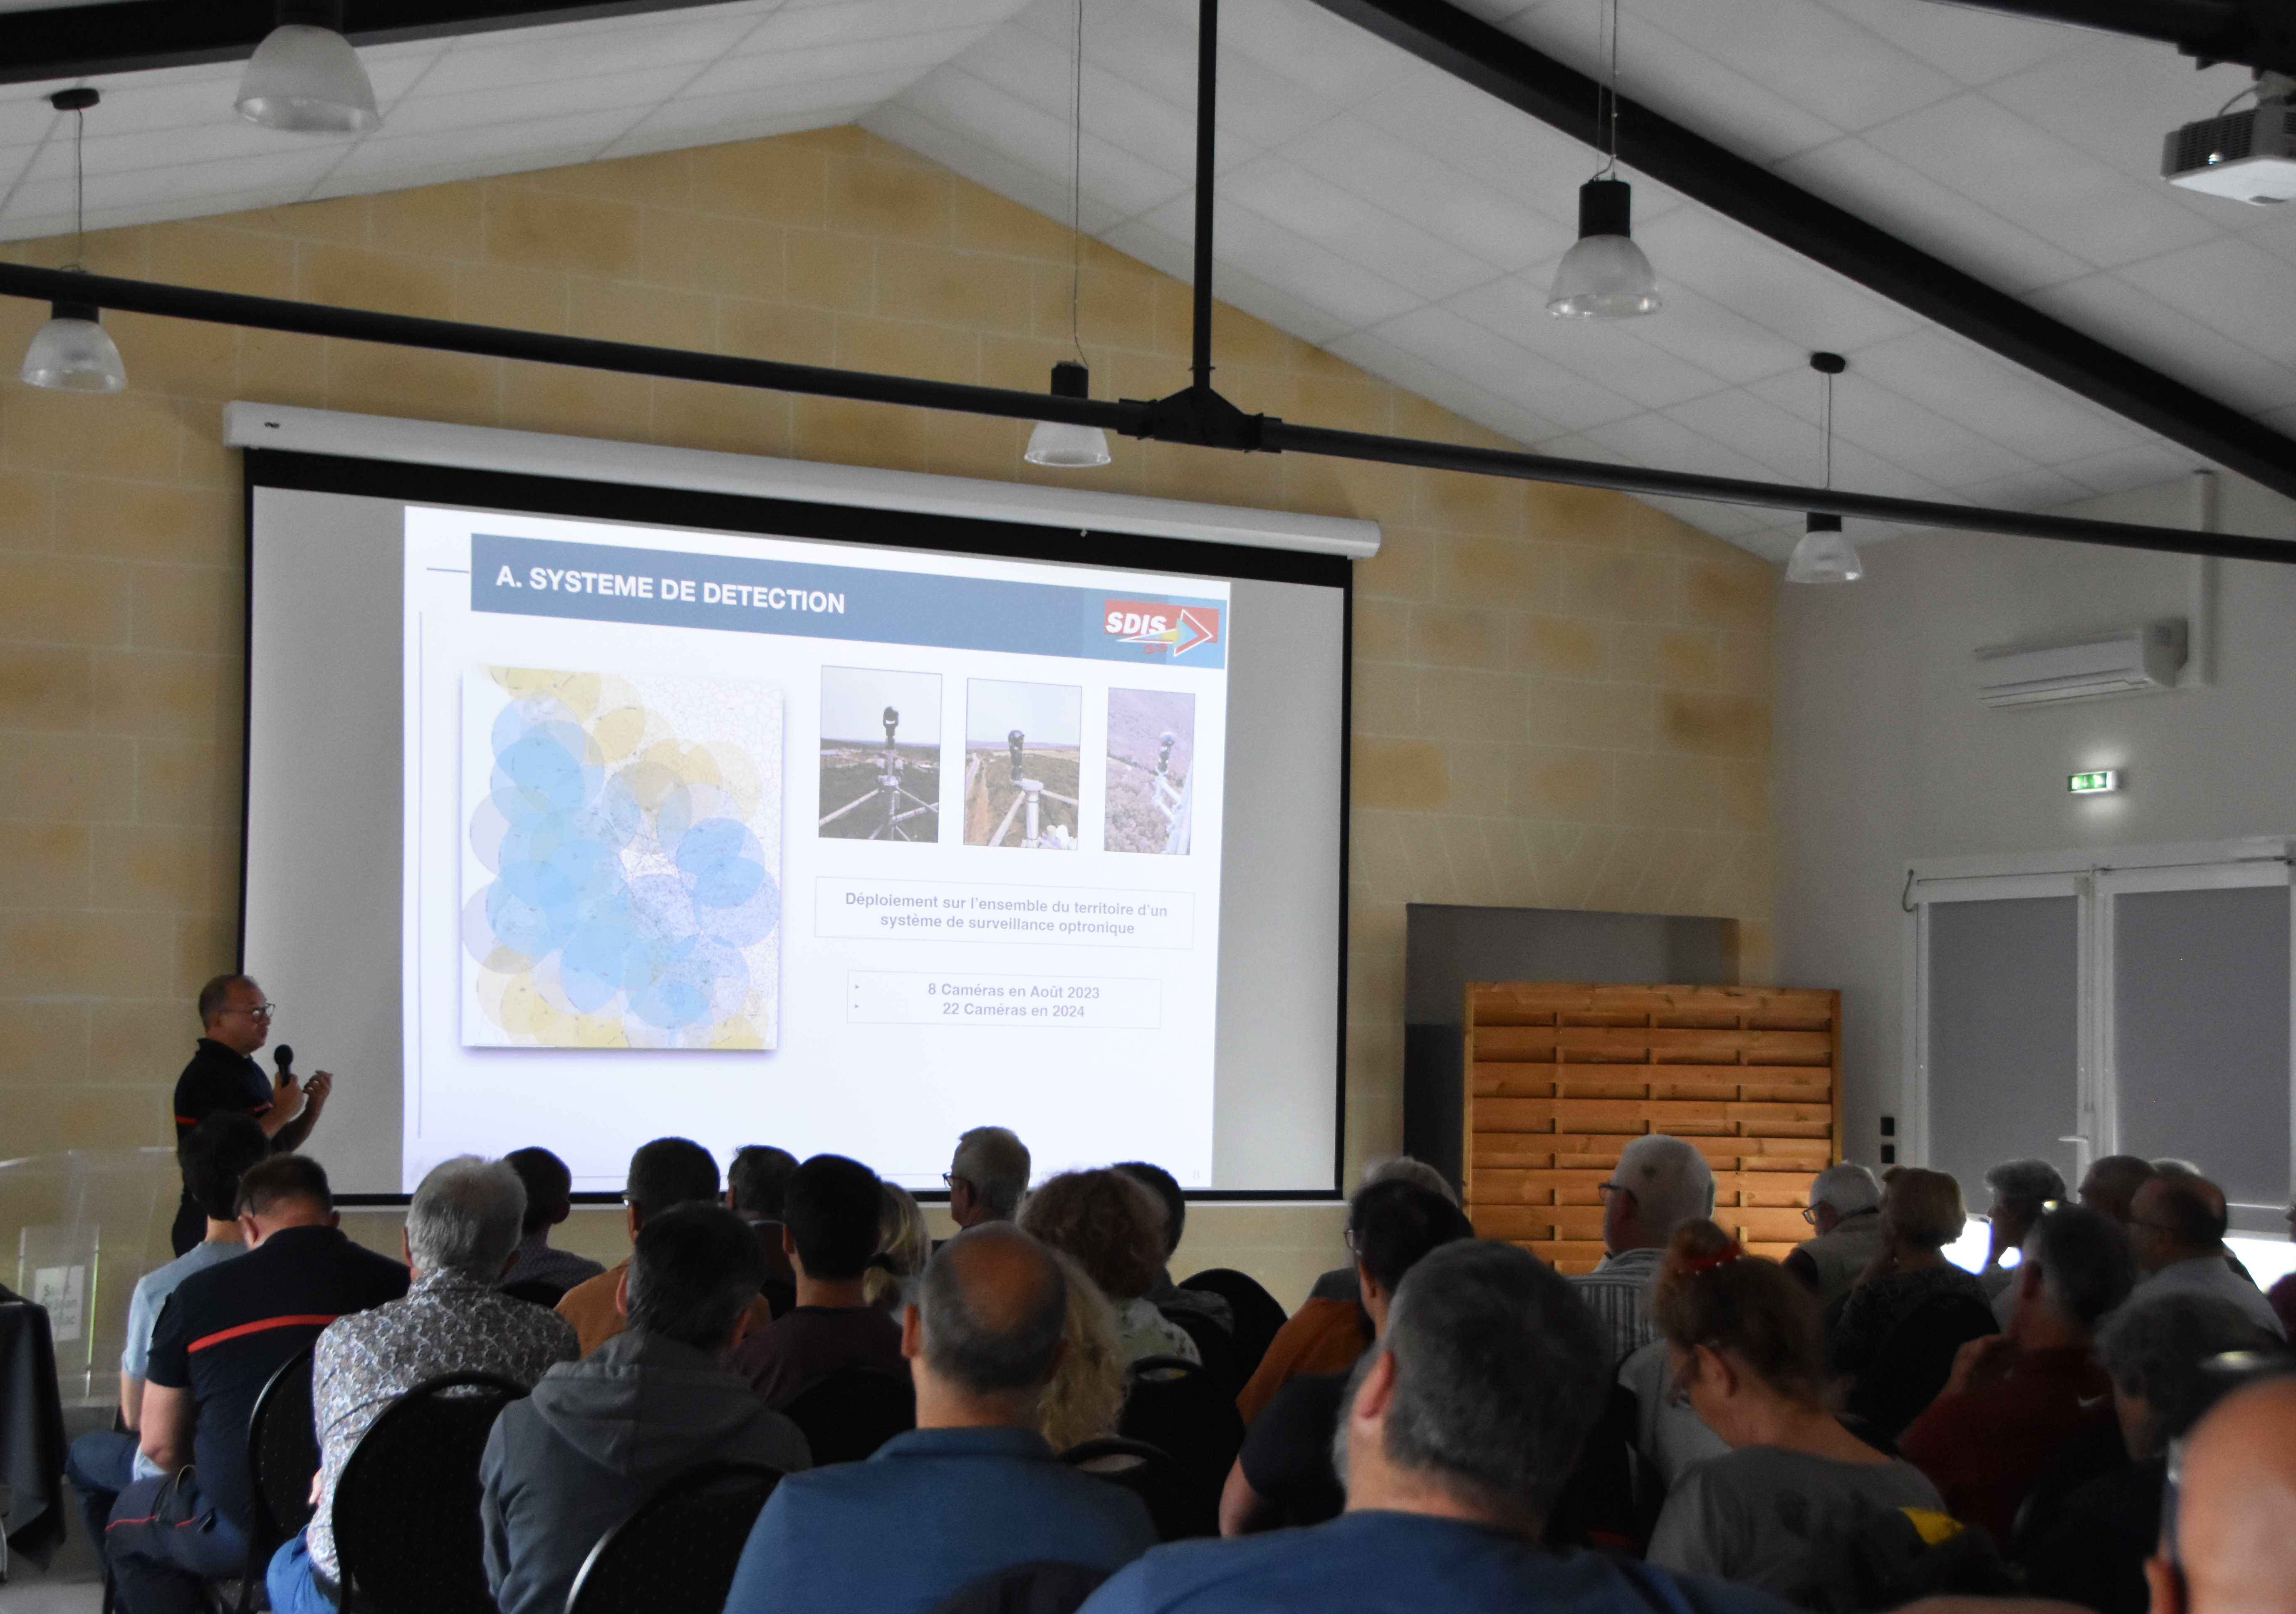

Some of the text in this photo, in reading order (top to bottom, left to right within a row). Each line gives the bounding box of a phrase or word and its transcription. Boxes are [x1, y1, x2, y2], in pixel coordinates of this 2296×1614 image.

[496, 565, 844, 614] A. SYSTEME DE DETECTION
[1106, 612, 1166, 634] SDIS
[846, 893, 1167, 916] Déploiement sur l’ensemble du territoire d’un
[881, 914, 1134, 936] système de surveillance optronique
[928, 983, 1099, 999] 8 Caméras en Août 2023
[943, 1003, 1084, 1017] 22 Caméras en 2024
